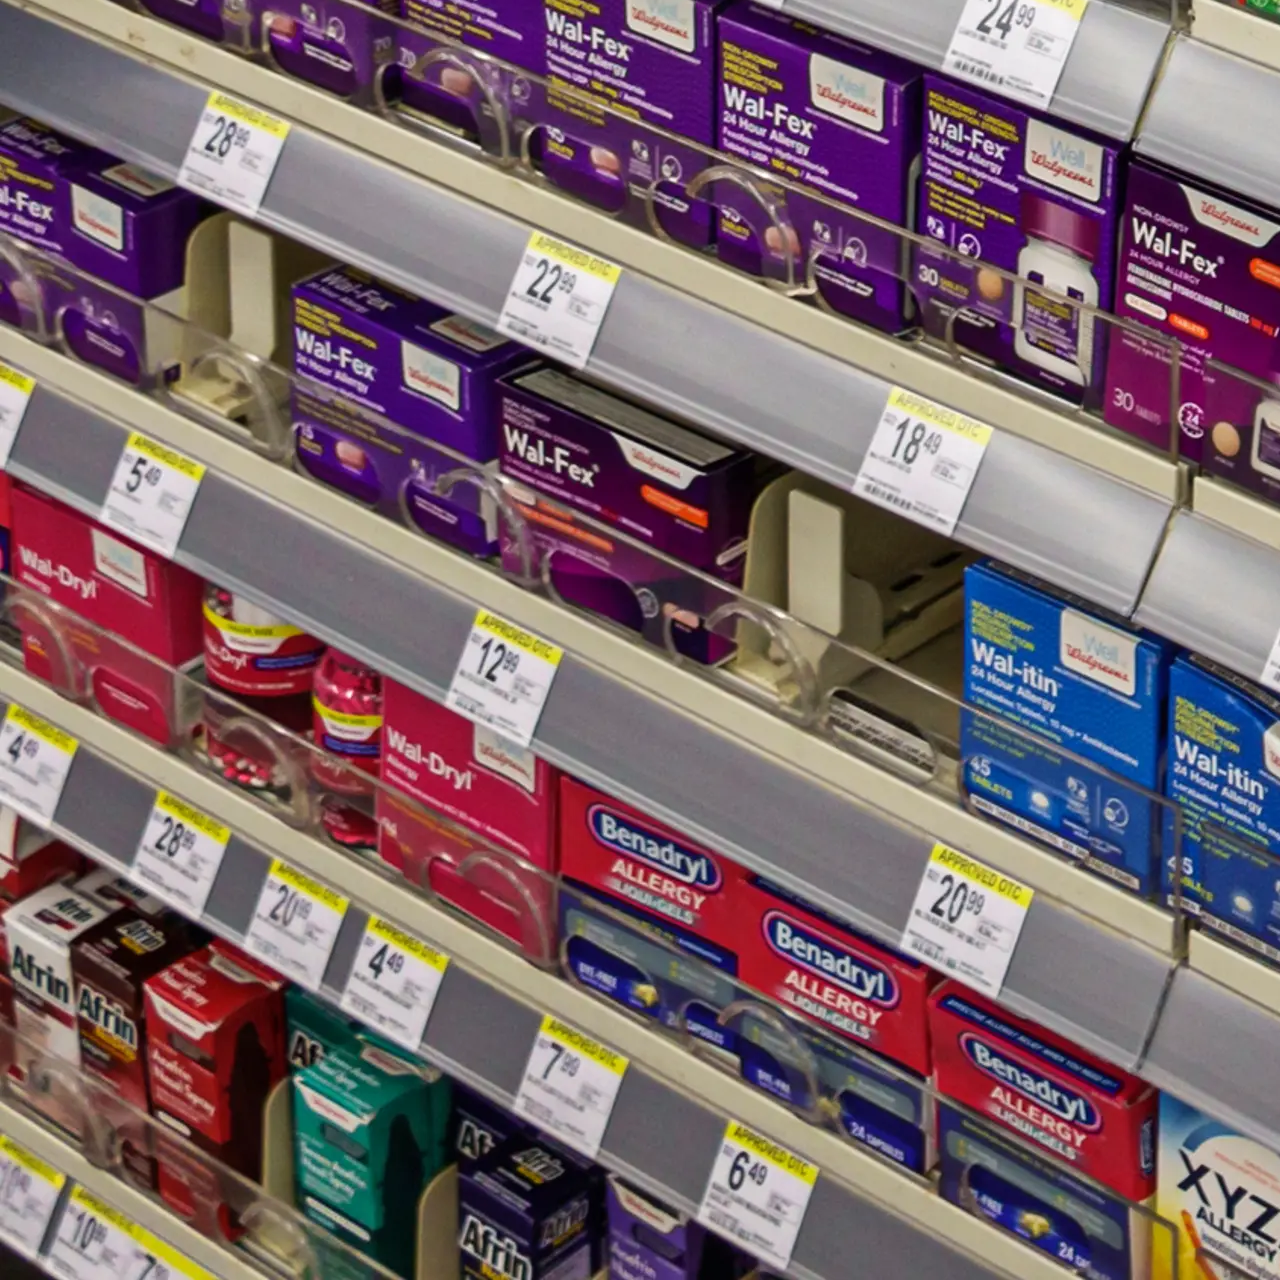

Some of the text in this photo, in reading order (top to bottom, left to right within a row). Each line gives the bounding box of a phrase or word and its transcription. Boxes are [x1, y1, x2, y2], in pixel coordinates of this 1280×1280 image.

[545, 10, 631, 60] Wal-Fex
[1132, 219, 1222, 278] Wal-Fex
[504, 426, 598, 487] Wal-Fex
[386, 724, 473, 791] Wal-Dryl
[776, 918, 884, 998] Benadryl
[79, 988, 136, 1045] Afrin
[785, 968, 883, 1026] ALLERGY
[973, 1042, 1086, 1121] Benadryl
[989, 1085, 1086, 1147] ALLERGY
